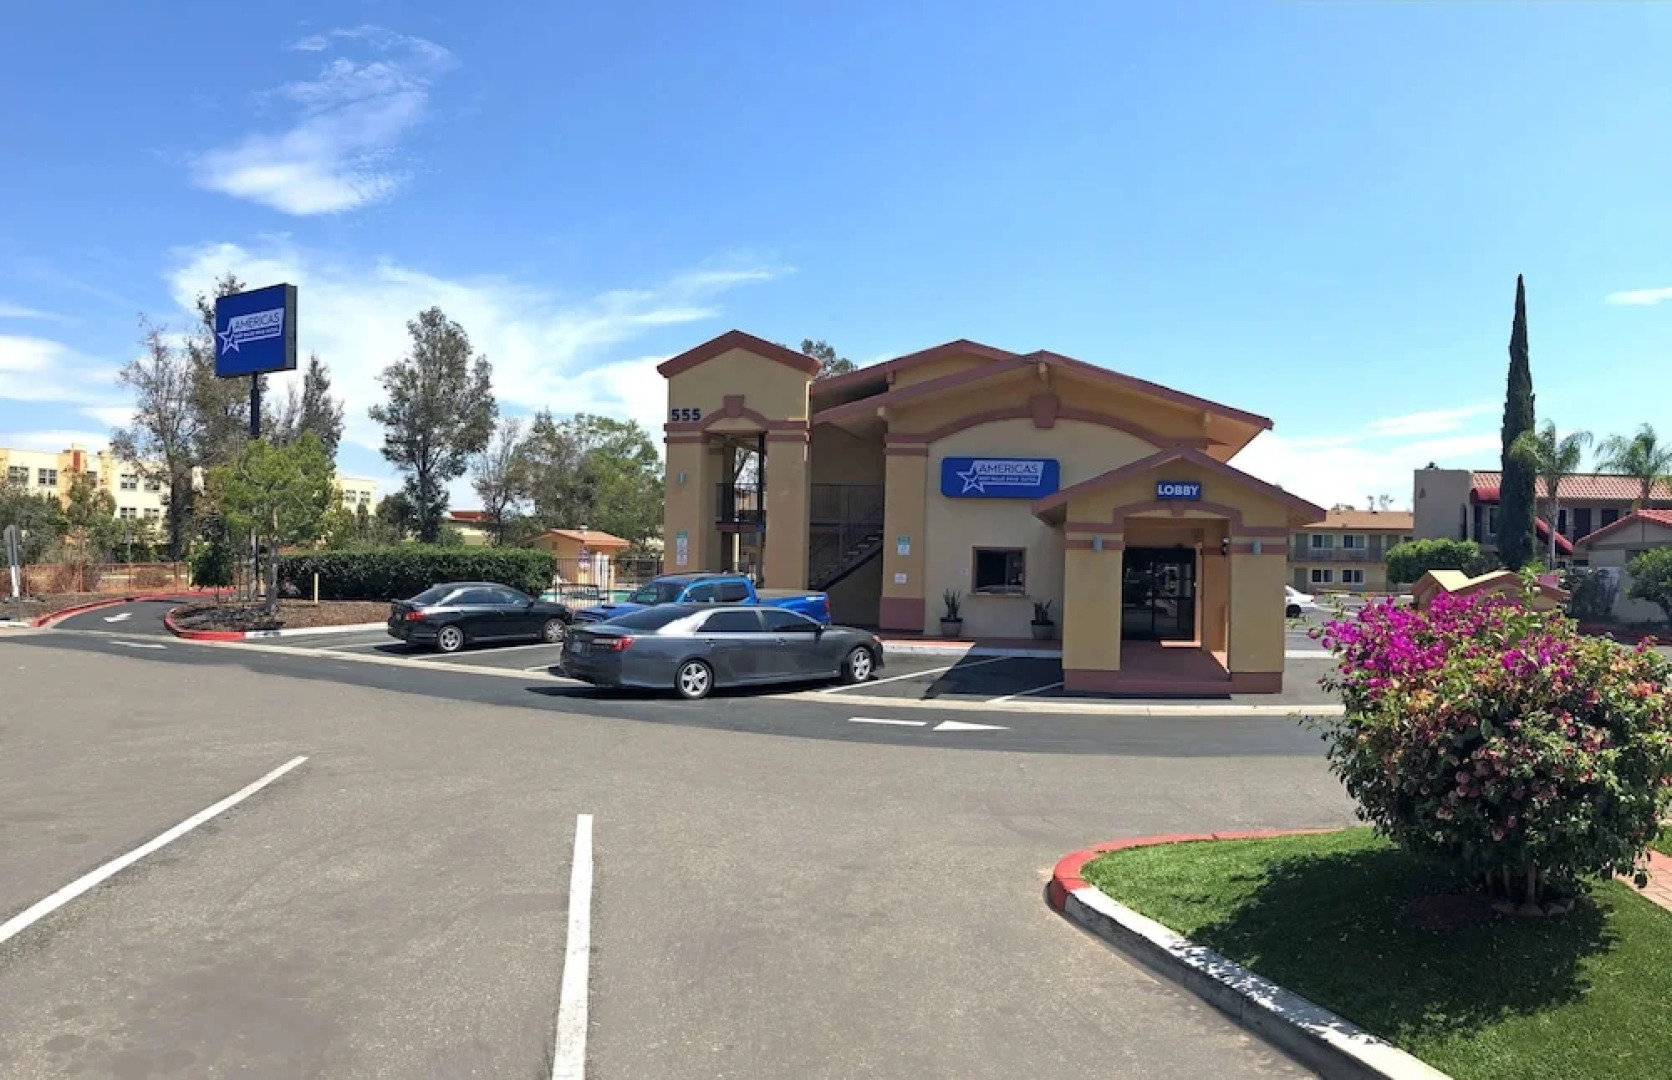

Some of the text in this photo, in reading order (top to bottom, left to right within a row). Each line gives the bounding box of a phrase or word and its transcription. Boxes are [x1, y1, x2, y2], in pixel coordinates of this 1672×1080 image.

[235, 312, 280, 329] AMERICAS
[671, 408, 701, 421] 555
[979, 464, 1038, 474] AMERICAS
[1158, 484, 1199, 496] LOBBY
